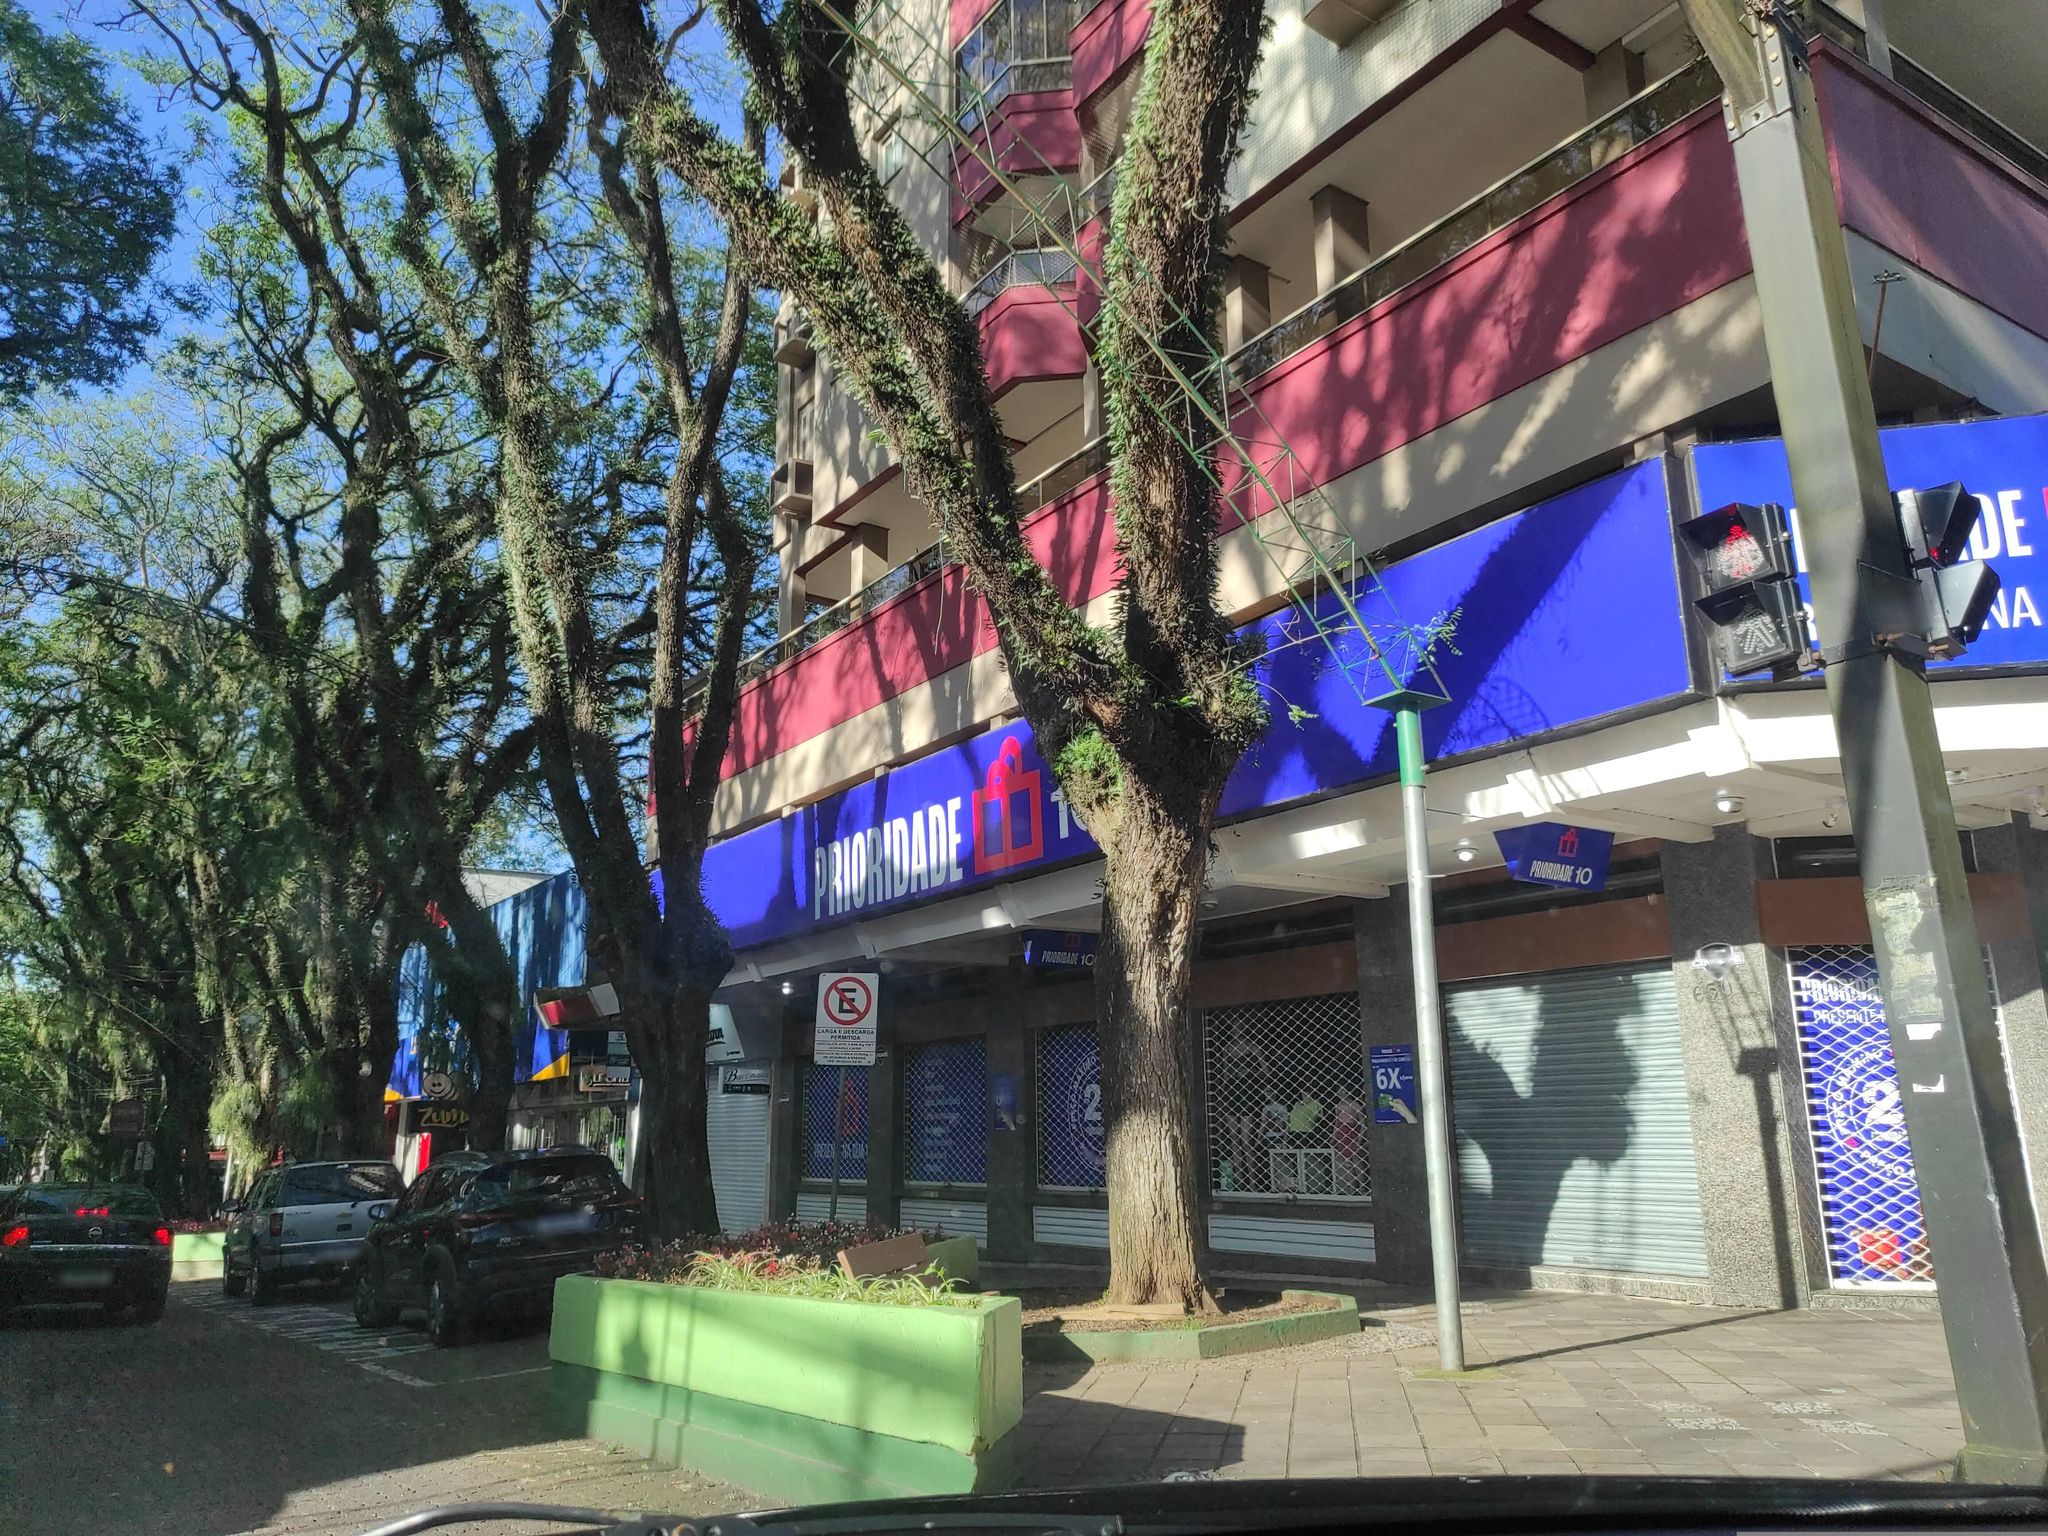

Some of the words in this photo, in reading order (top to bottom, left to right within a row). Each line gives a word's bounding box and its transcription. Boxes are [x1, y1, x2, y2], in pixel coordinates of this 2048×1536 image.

[814, 796, 964, 921] PRIORIDADE
[1529, 859, 1575, 882] PRIORIDADE
[1576, 866, 1593, 885] 10
[1041, 950, 1080, 965] PRIORIDADE
[1375, 1067, 1402, 1090] 6X
